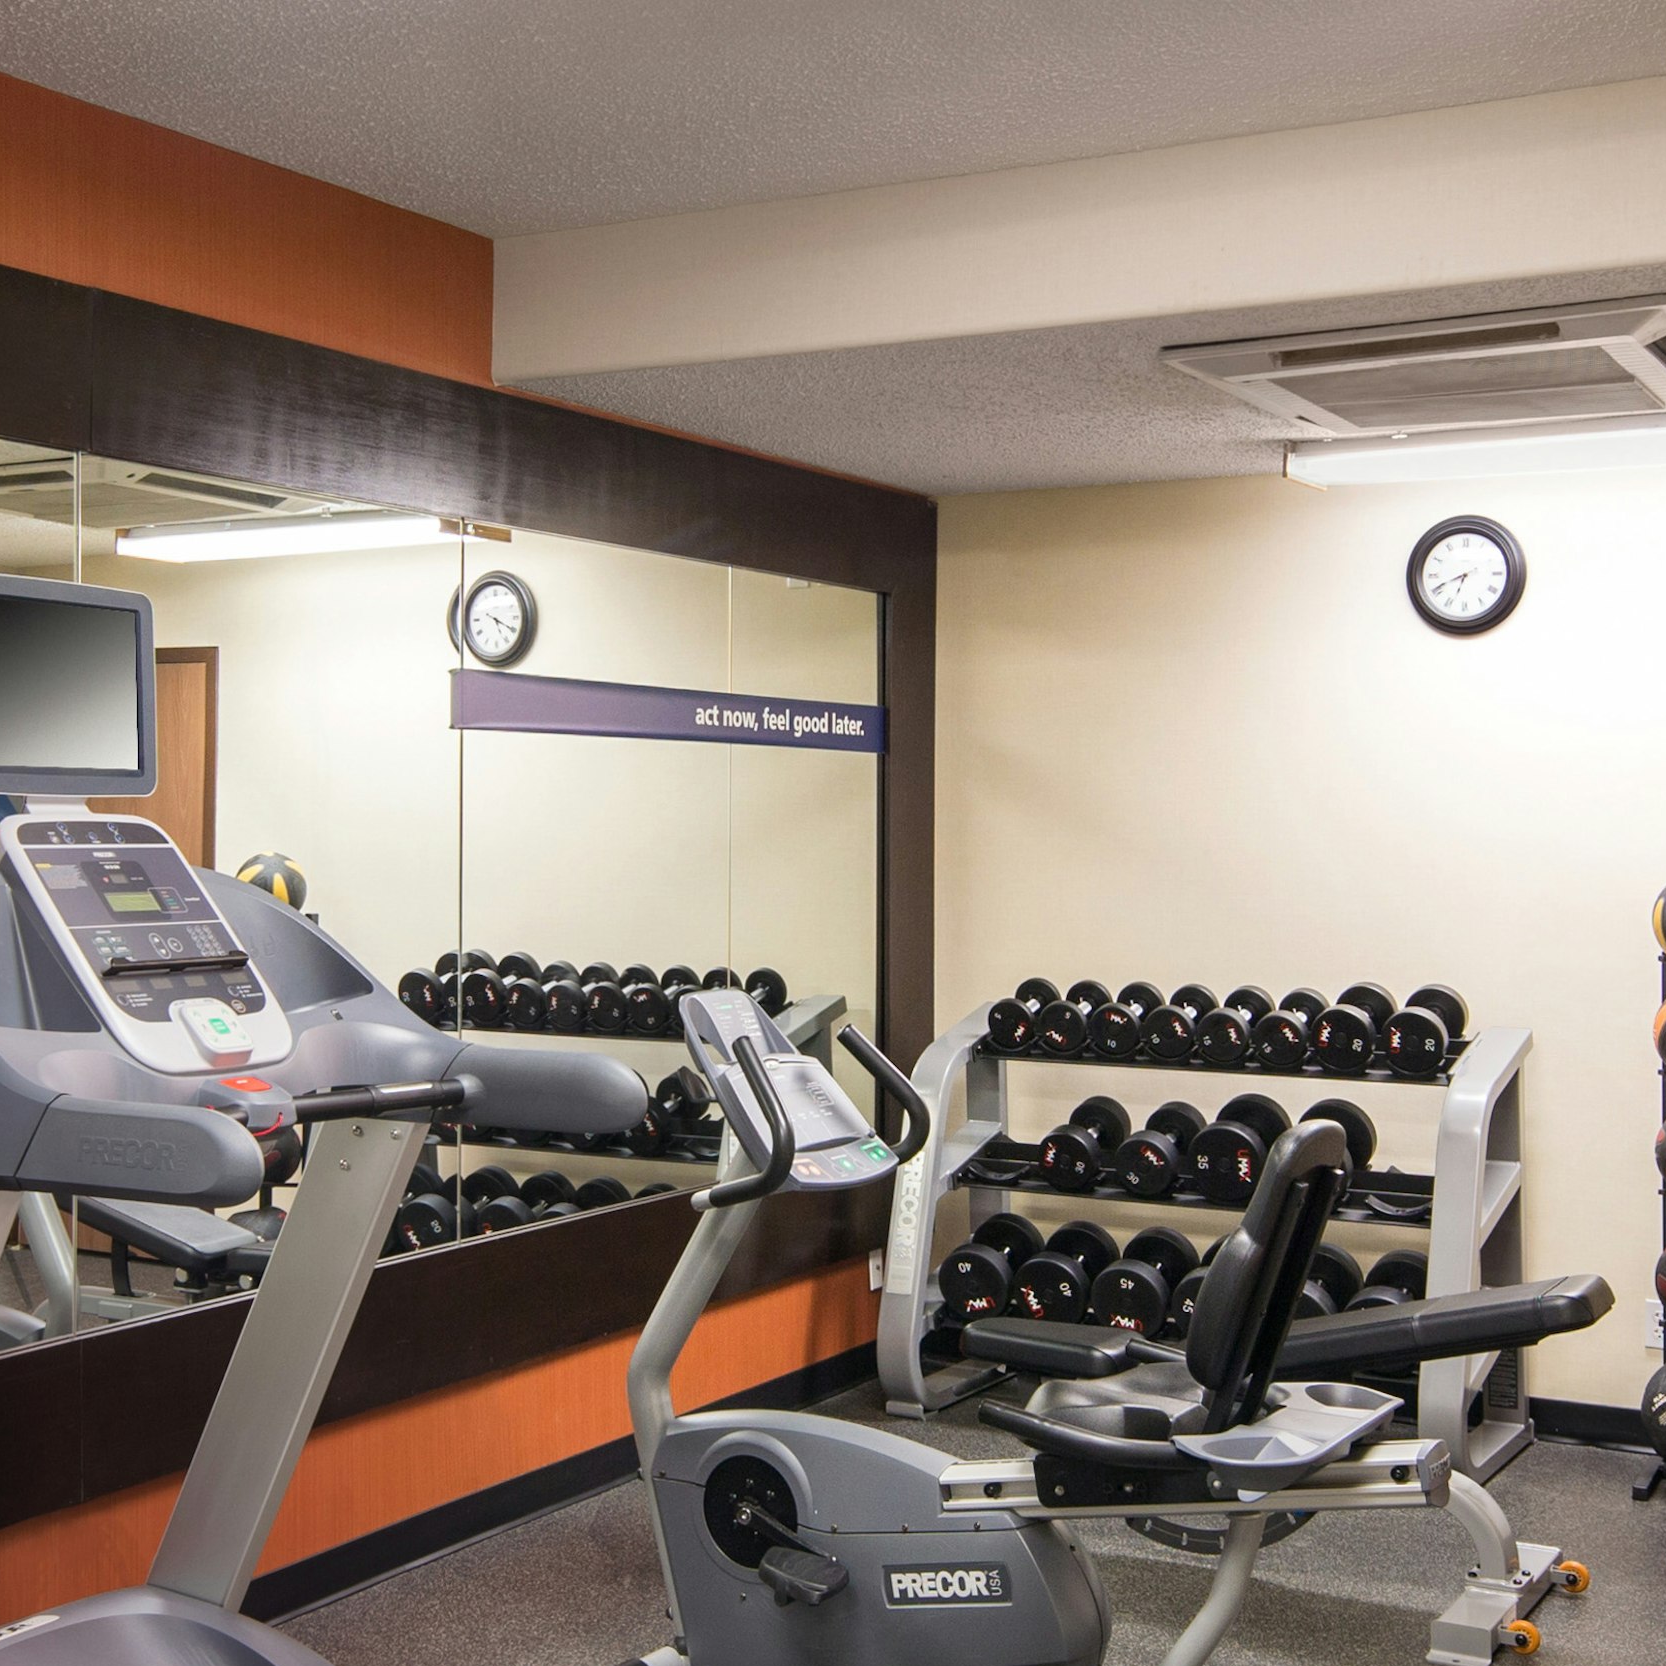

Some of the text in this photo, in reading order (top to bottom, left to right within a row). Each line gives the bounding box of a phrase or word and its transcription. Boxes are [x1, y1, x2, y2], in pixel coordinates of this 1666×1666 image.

[695, 705, 865, 738] act now, feel good later.
[1107, 1039, 1117, 1048] 10
[1150, 1033, 1161, 1045] 10
[1202, 1035, 1212, 1047] 15
[1352, 1038, 1363, 1052] 20
[1425, 1038, 1436, 1052] 20
[1261, 1042, 1273, 1054] 15
[1074, 1160, 1085, 1175] 30
[1197, 1154, 1209, 1170] 35
[1236, 1148, 1253, 1184] UMAX
[1125, 1171, 1140, 1185] 30
[897, 1150, 926, 1247] PRECOR
[957, 1262, 972, 1274] 40
[1059, 1281, 1073, 1298] 40
[1119, 1277, 1135, 1290] 45
[1182, 1297, 1195, 1314] 45
[1110, 1313, 1145, 1333] UMAX
[890, 1569, 1003, 1599] PRECOR USA
